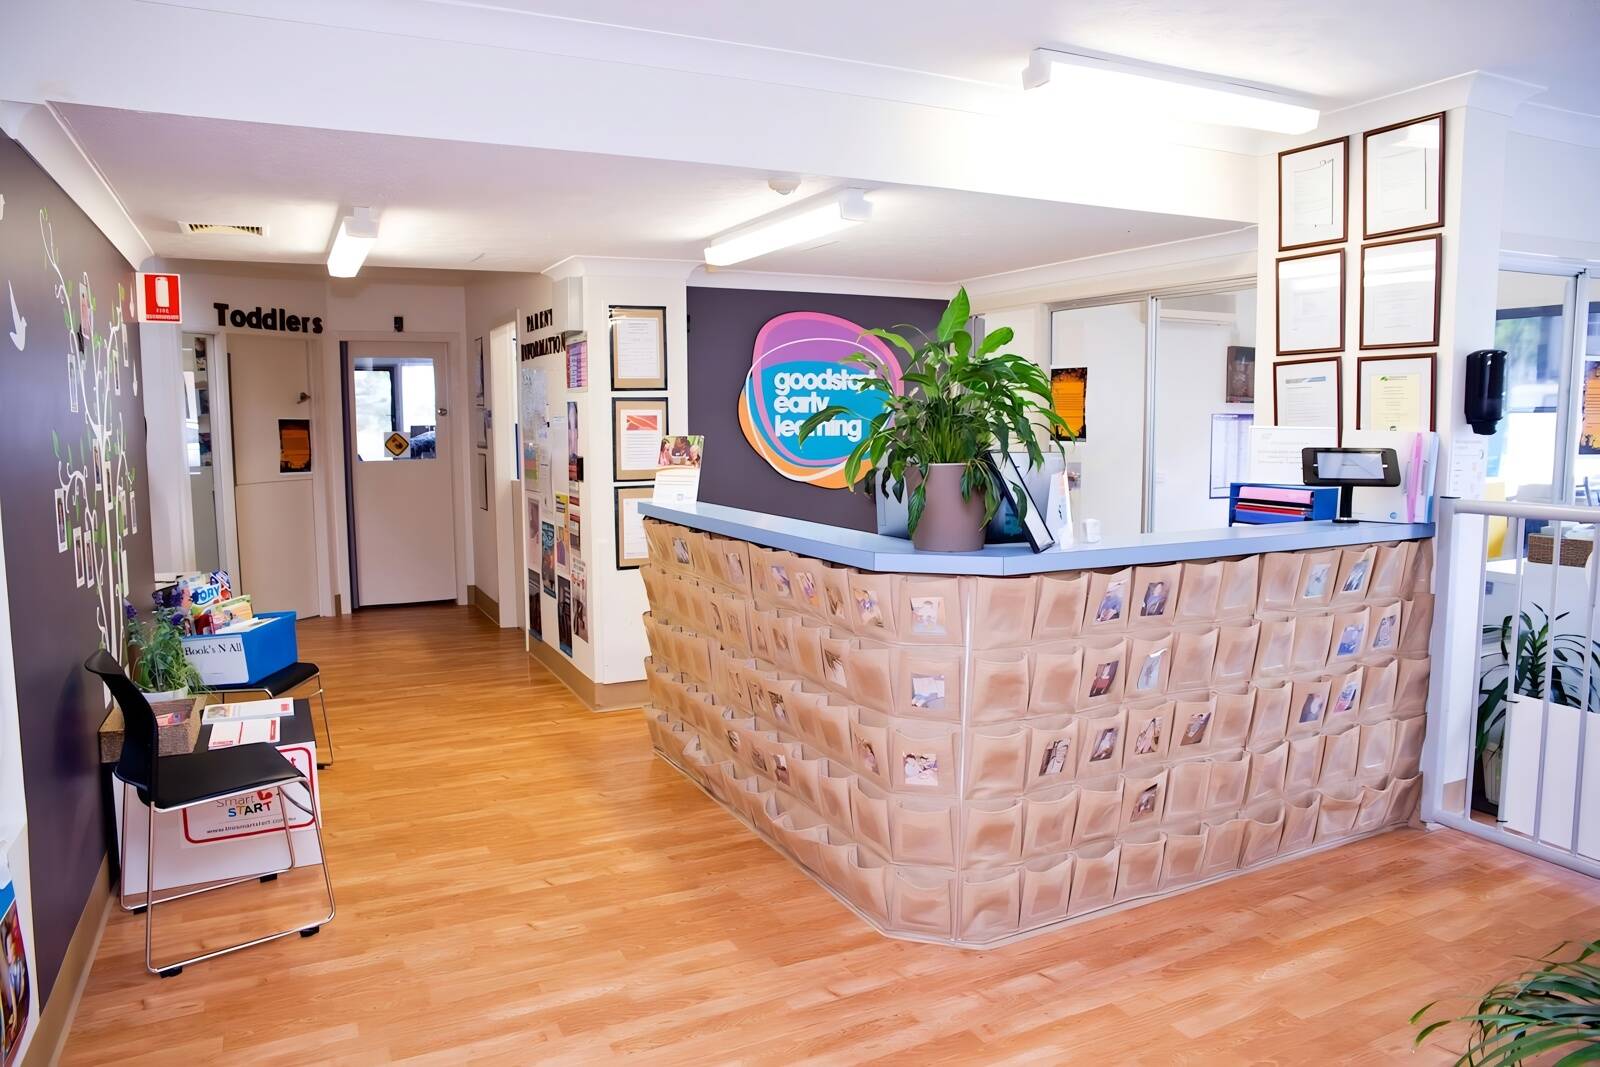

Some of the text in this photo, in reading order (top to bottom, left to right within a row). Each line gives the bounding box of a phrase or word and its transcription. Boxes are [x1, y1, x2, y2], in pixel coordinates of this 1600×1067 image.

[213, 302, 323, 334] Toddlers
[526, 308, 553, 333] PARENT
[520, 331, 566, 362] INFORMATION
[774, 414, 862, 442] lening
[184, 642, 242, 656] Book's N All
[228, 801, 273, 818] START
